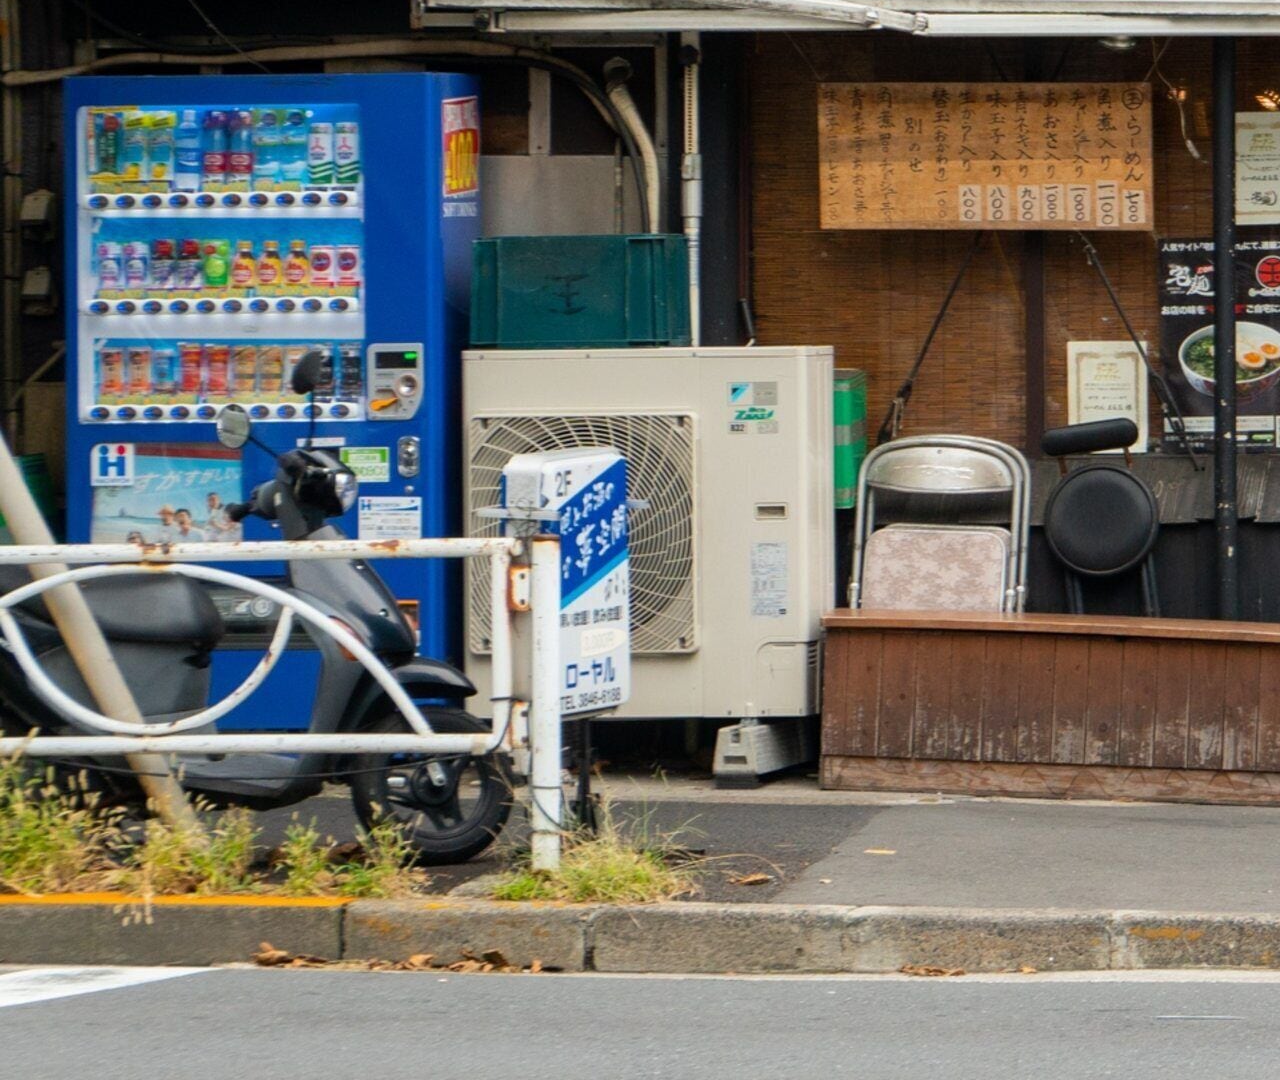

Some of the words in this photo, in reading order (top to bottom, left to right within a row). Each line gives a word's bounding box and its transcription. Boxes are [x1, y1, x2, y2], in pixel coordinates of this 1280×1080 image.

[556, 470, 571, 497] 2F
[566, 657, 615, 689] ローヤル
